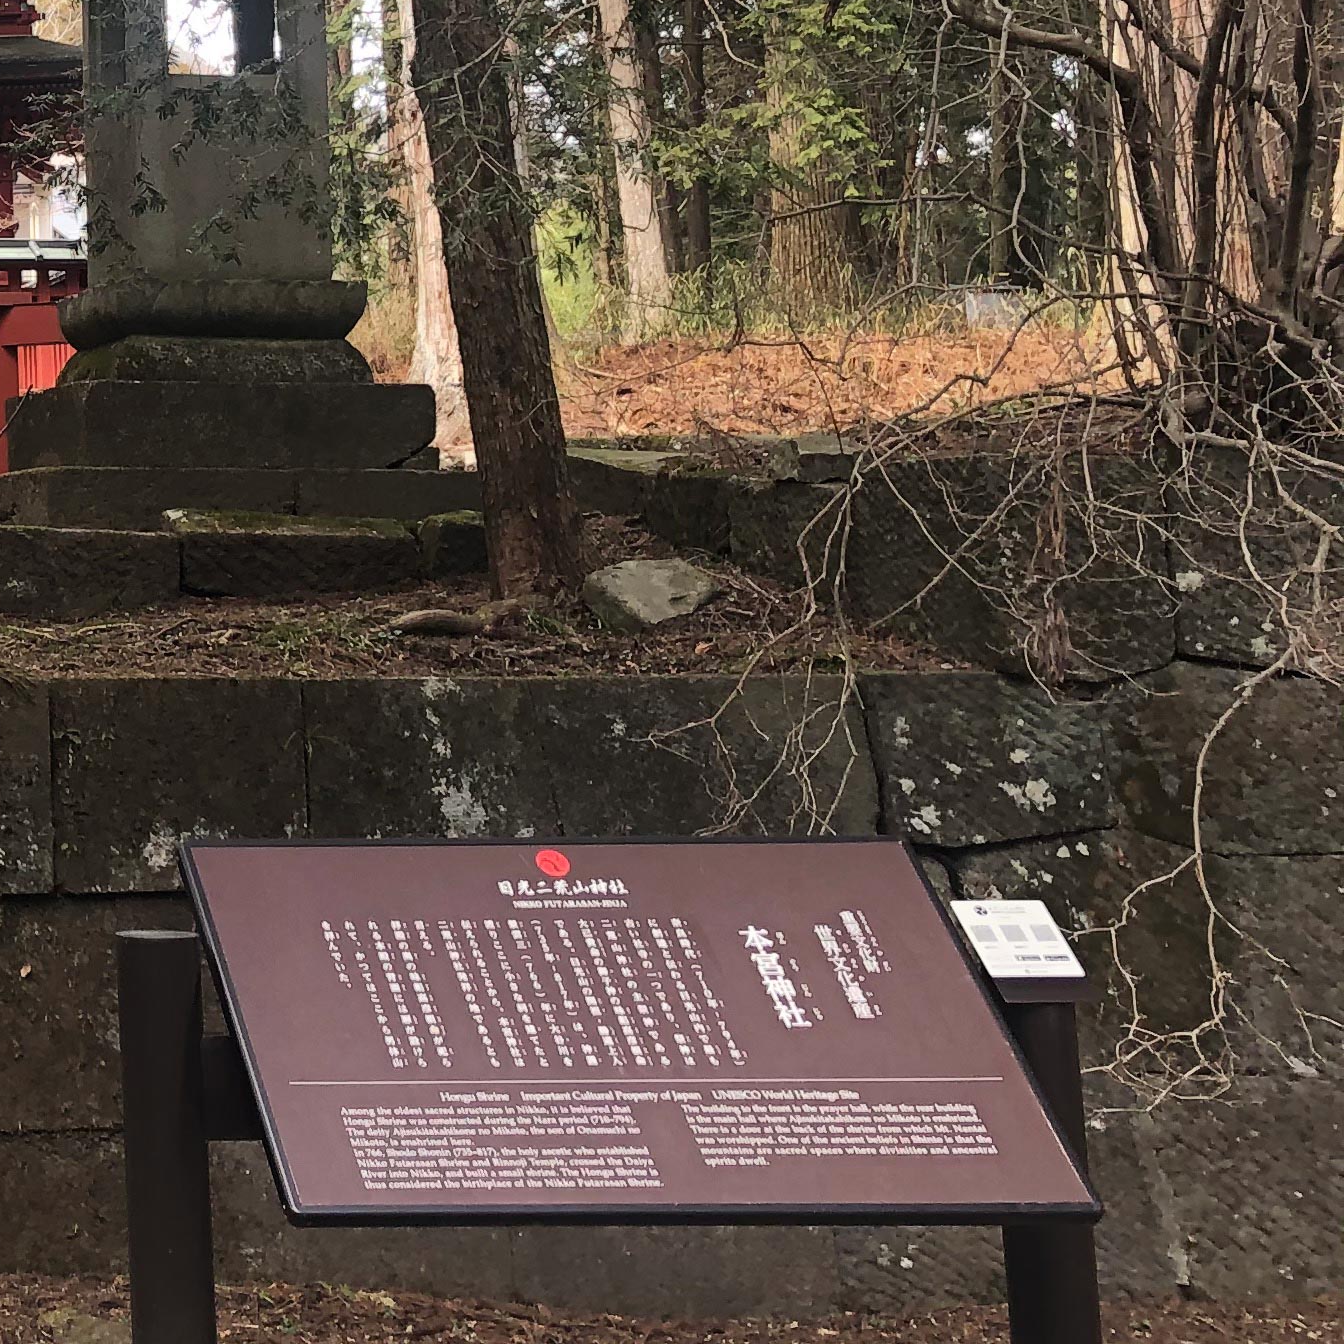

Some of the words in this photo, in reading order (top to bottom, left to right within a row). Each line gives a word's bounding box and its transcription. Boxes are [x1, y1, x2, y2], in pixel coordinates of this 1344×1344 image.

[498, 878, 629, 896] 日光二荒山神社
[512, 899, 543, 909] NIKKO
[543, 899, 628, 908] FUTARASAN-JINJA
[839, 910, 881, 973] 重要文化財
[738, 925, 813, 1029] 本宮神社
[813, 924, 876, 1019] 世界文化遺産
[440, 1092, 476, 1104] Hongu
[476, 1091, 509, 1101] Shrine
[520, 1091, 571, 1103] Important
[572, 1091, 614, 1100] Cultural
[614, 1091, 658, 1102] Property
[671, 1090, 702, 1102] Japan
[761, 1090, 794, 1099] World
[794, 1090, 839, 1102] Heritage
[839, 1090, 859, 1099] Site
